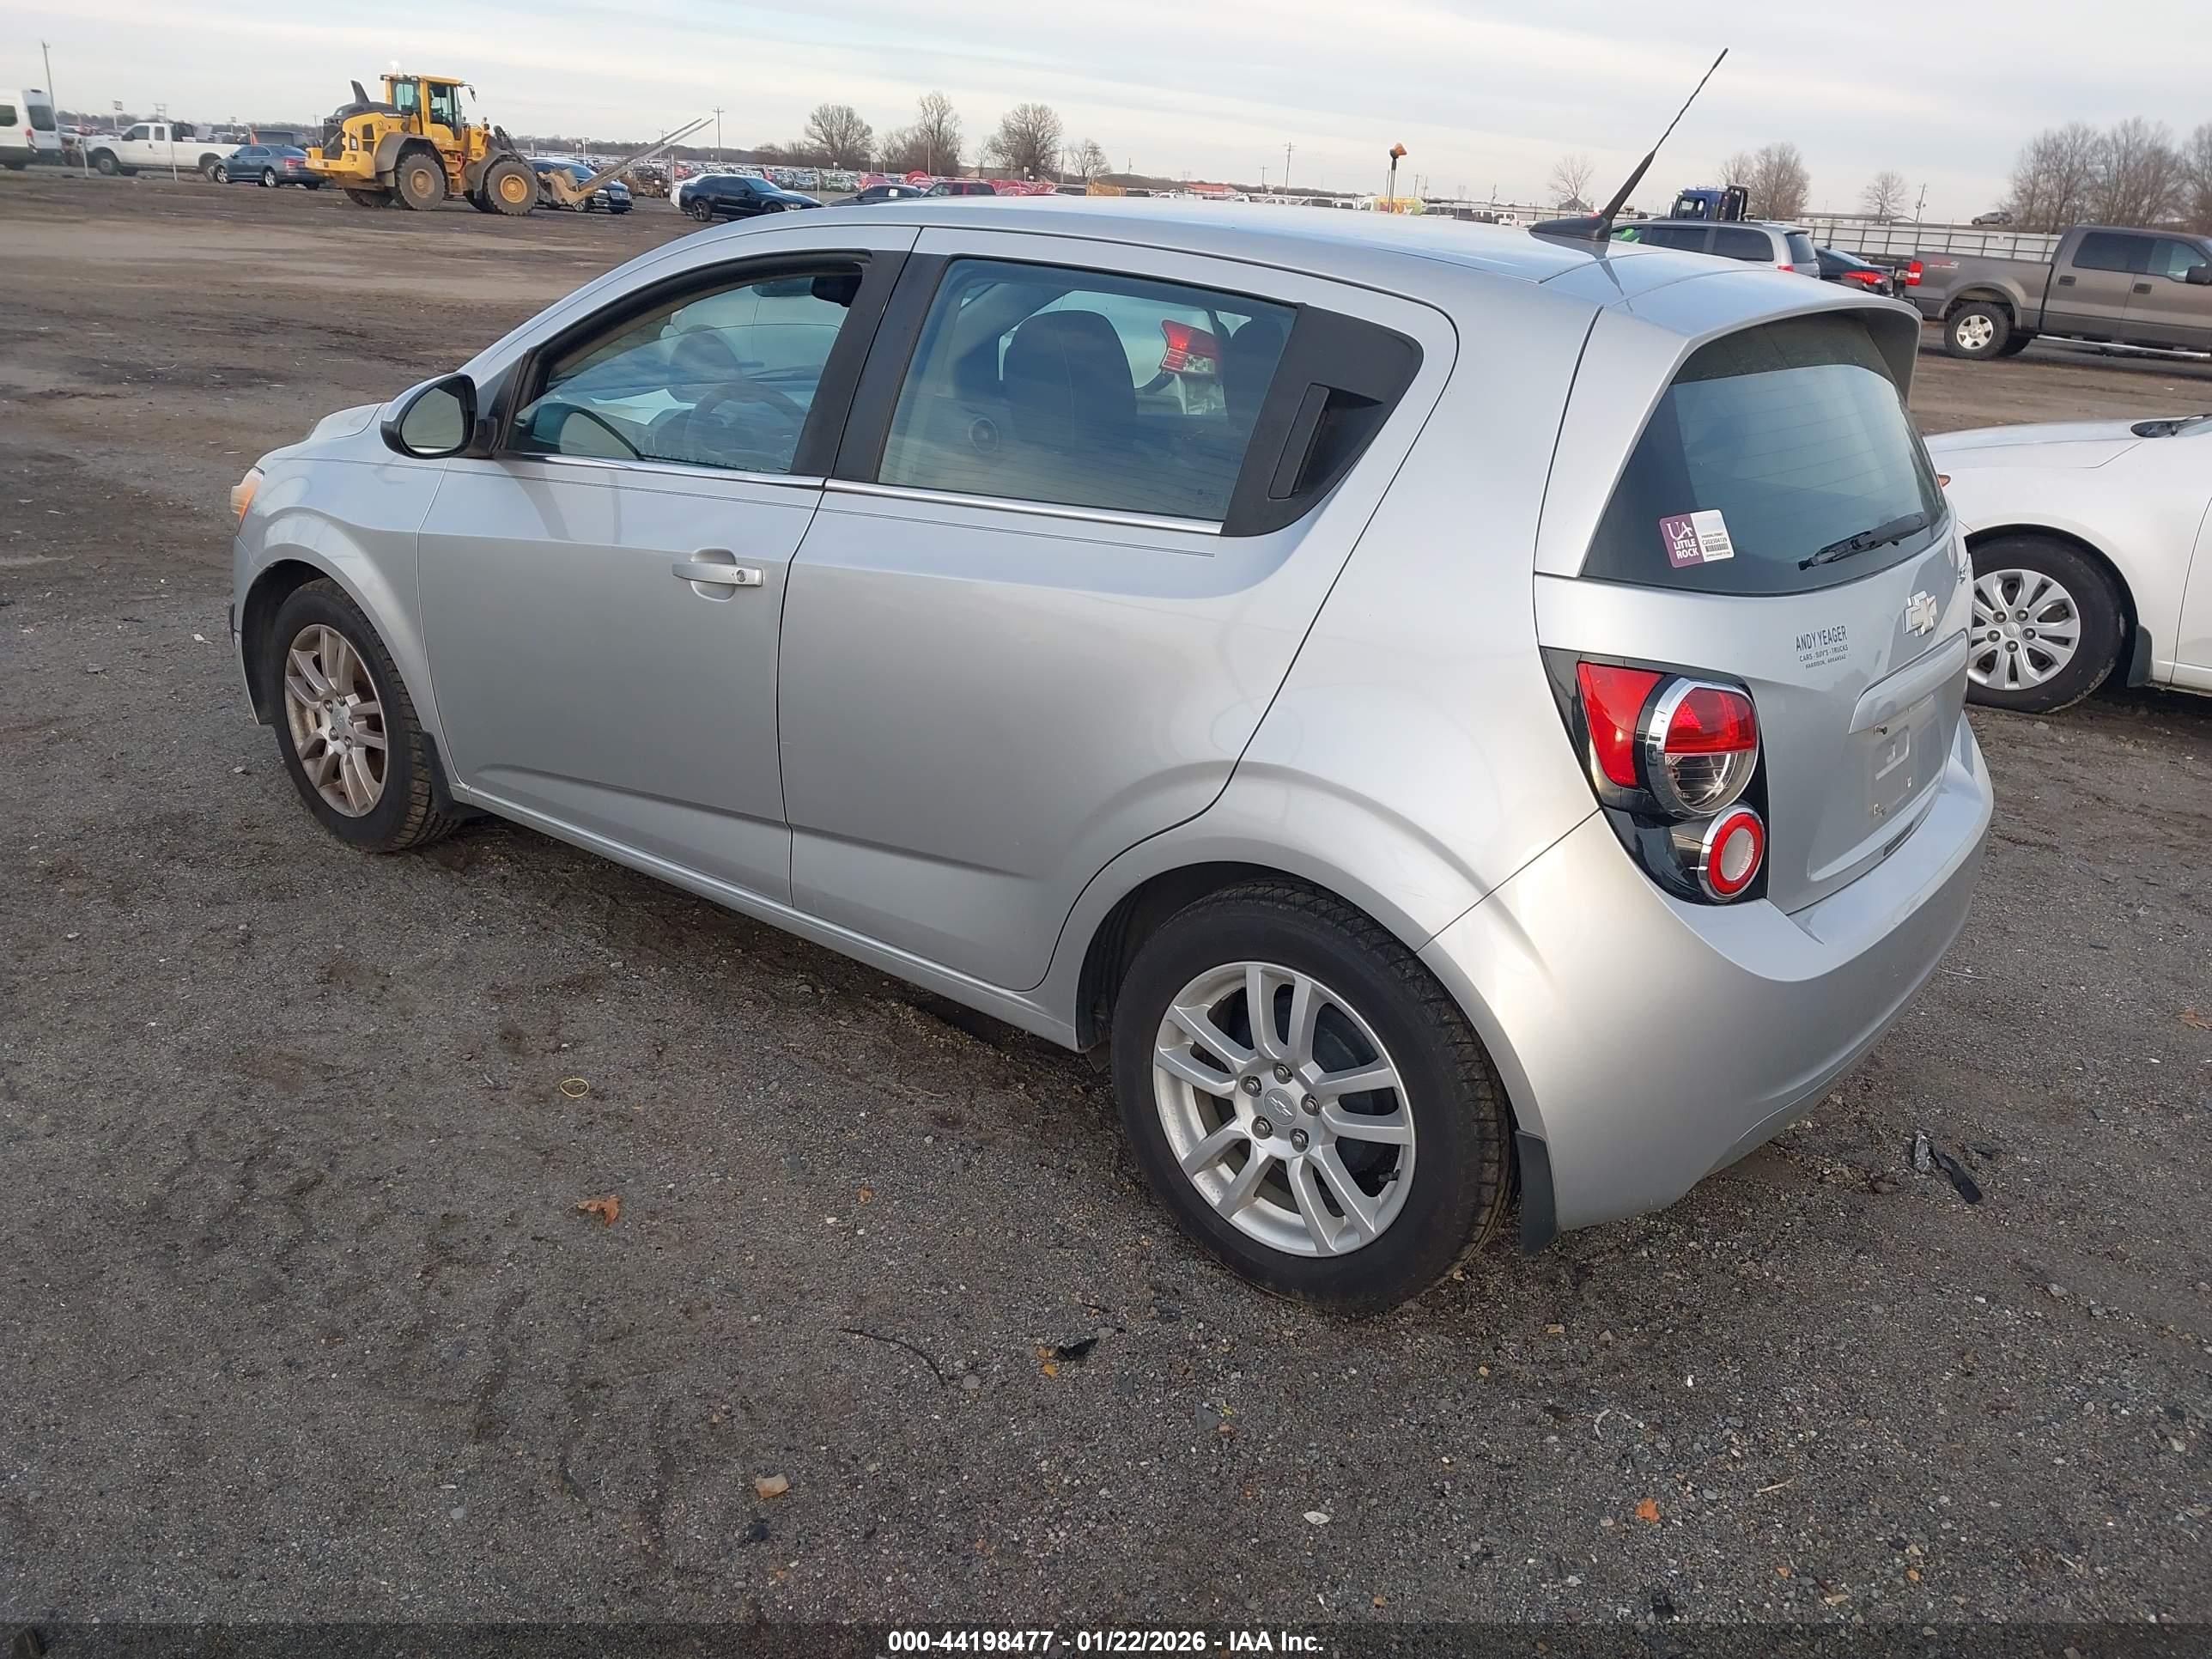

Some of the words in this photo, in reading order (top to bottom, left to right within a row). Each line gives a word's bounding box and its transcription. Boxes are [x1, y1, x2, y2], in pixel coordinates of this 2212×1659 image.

[1673, 538, 1698, 550] LITTLE
[1675, 547, 1699, 560] ROCK
[1796, 631, 1816, 652] ANDY
[1817, 625, 1848, 646] YEAGER
[1799, 653, 1814, 662] CARS
[1832, 644, 1849, 653] TRUCKS
